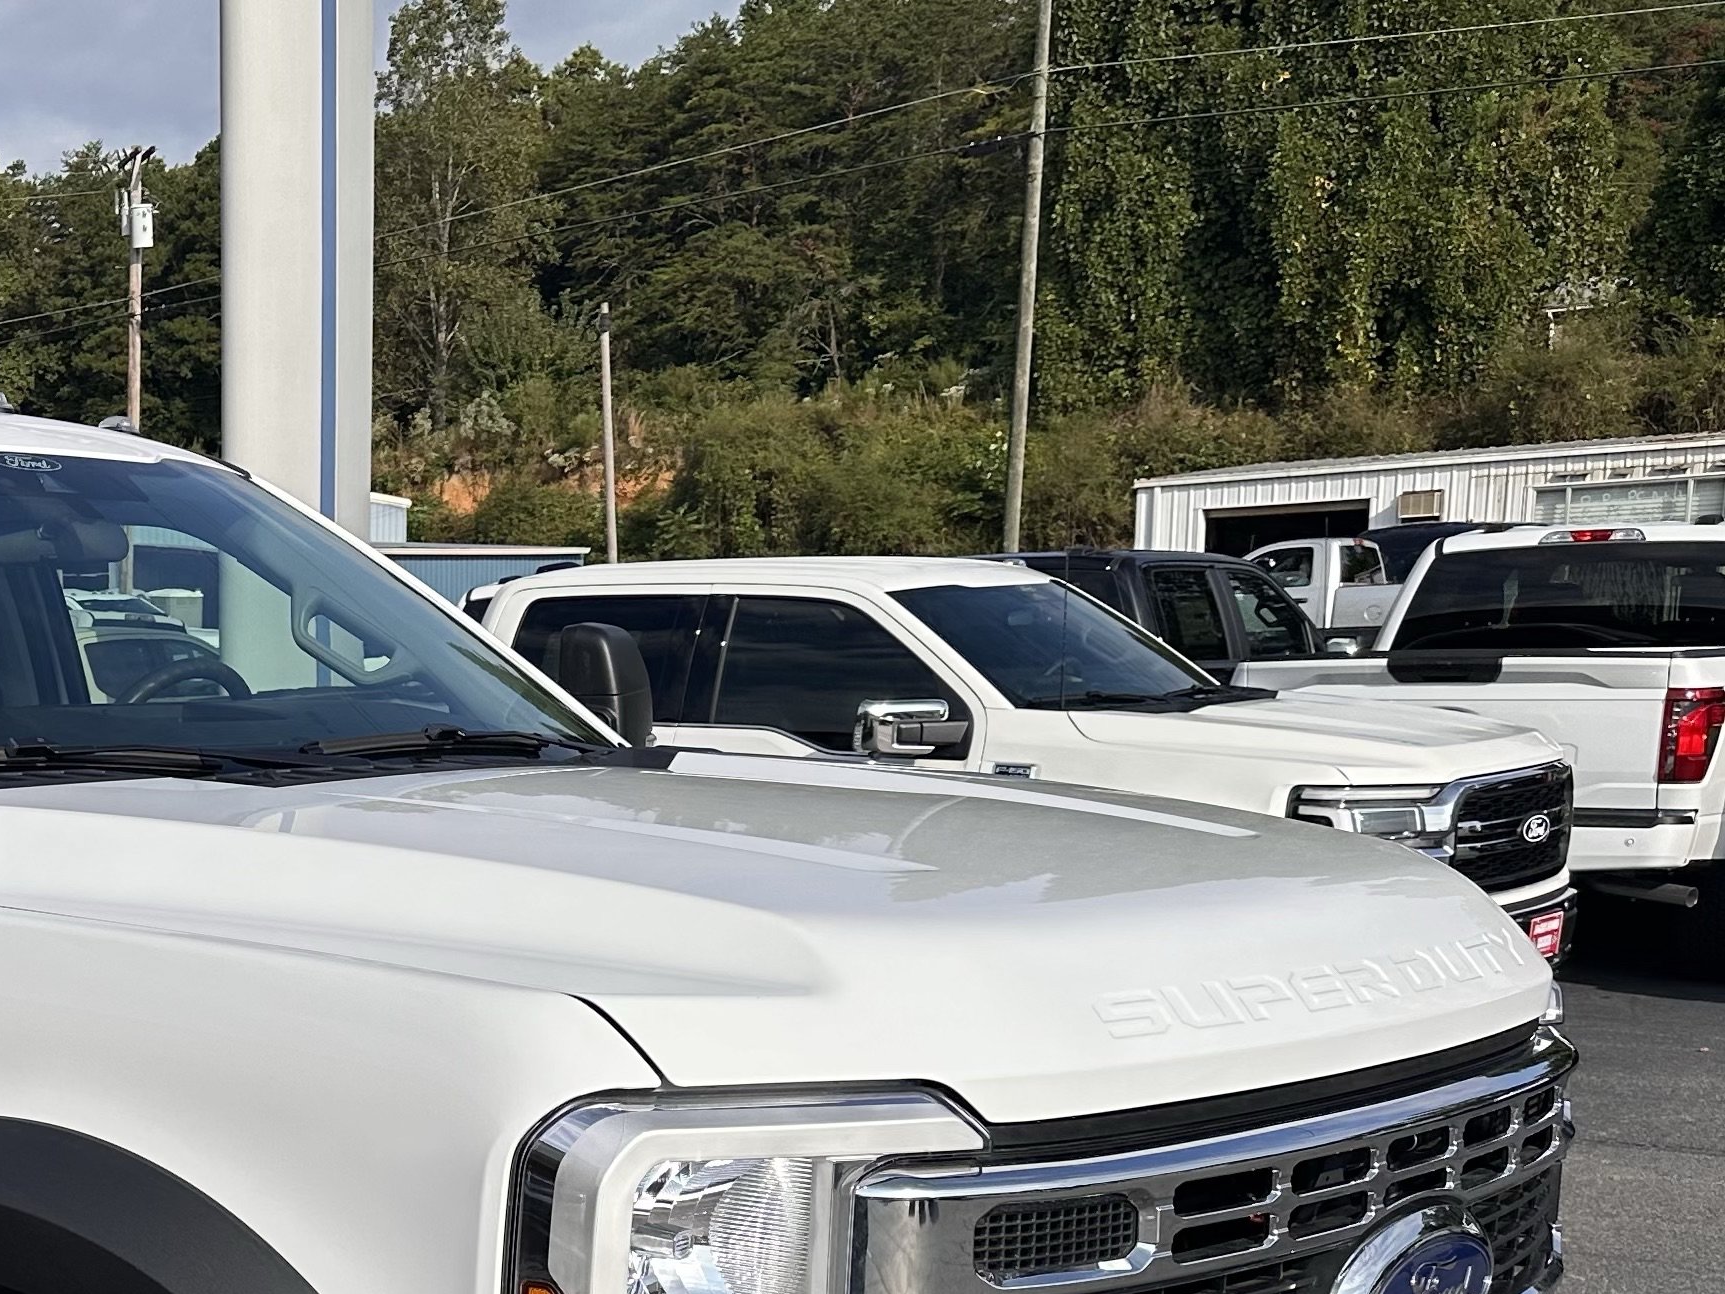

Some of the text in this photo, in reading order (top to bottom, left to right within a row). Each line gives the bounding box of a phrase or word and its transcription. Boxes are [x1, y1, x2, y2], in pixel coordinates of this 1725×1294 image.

[4, 455, 51, 469] Ford
[1092, 927, 1525, 1040] SUPER DUTY
